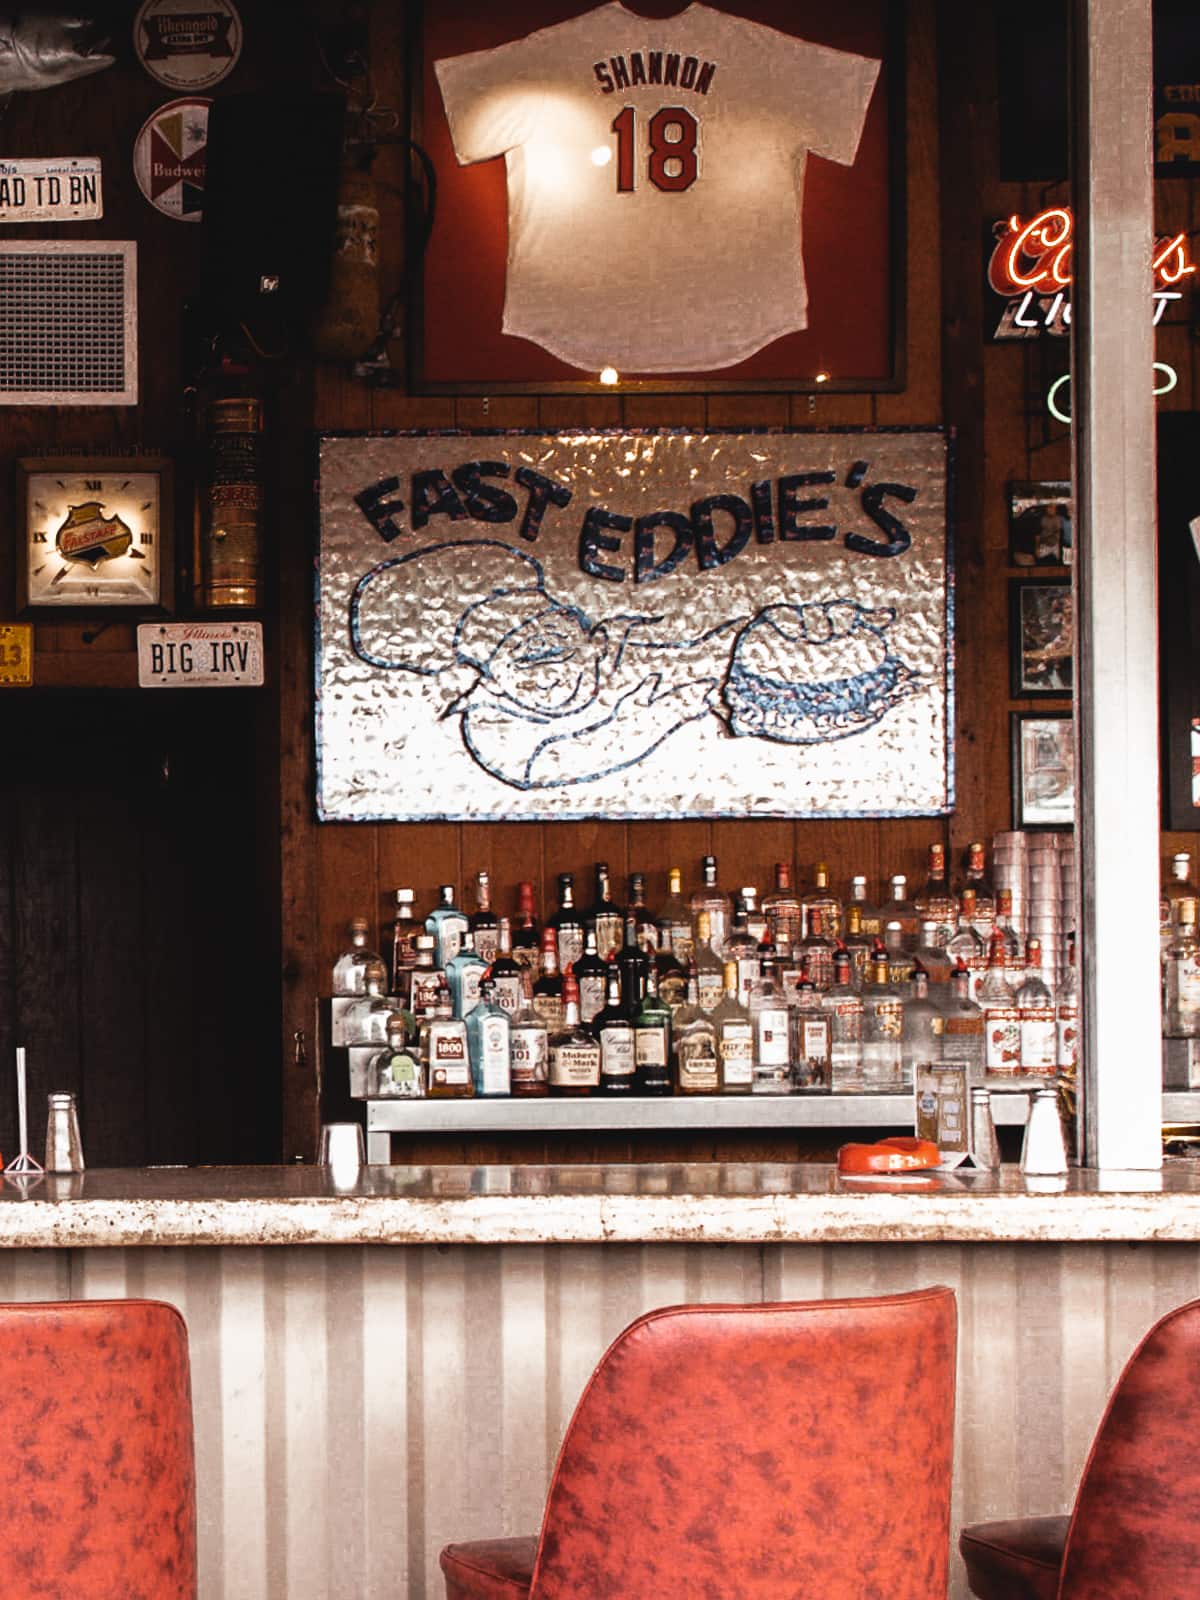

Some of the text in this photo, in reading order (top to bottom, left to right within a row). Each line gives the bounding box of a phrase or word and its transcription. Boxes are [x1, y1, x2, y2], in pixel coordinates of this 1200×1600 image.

[593, 51, 716, 96] SHANNON
[613, 106, 699, 194] 18
[151, 162, 207, 177] Budwei
[69, 175, 97, 205] BN
[354, 459, 918, 583] FAST EDDIE'S
[33, 532, 48, 544] IX
[140, 532, 154, 545] III
[151, 641, 249, 674] BIG IRV
[438, 1042, 461, 1054] 1800
